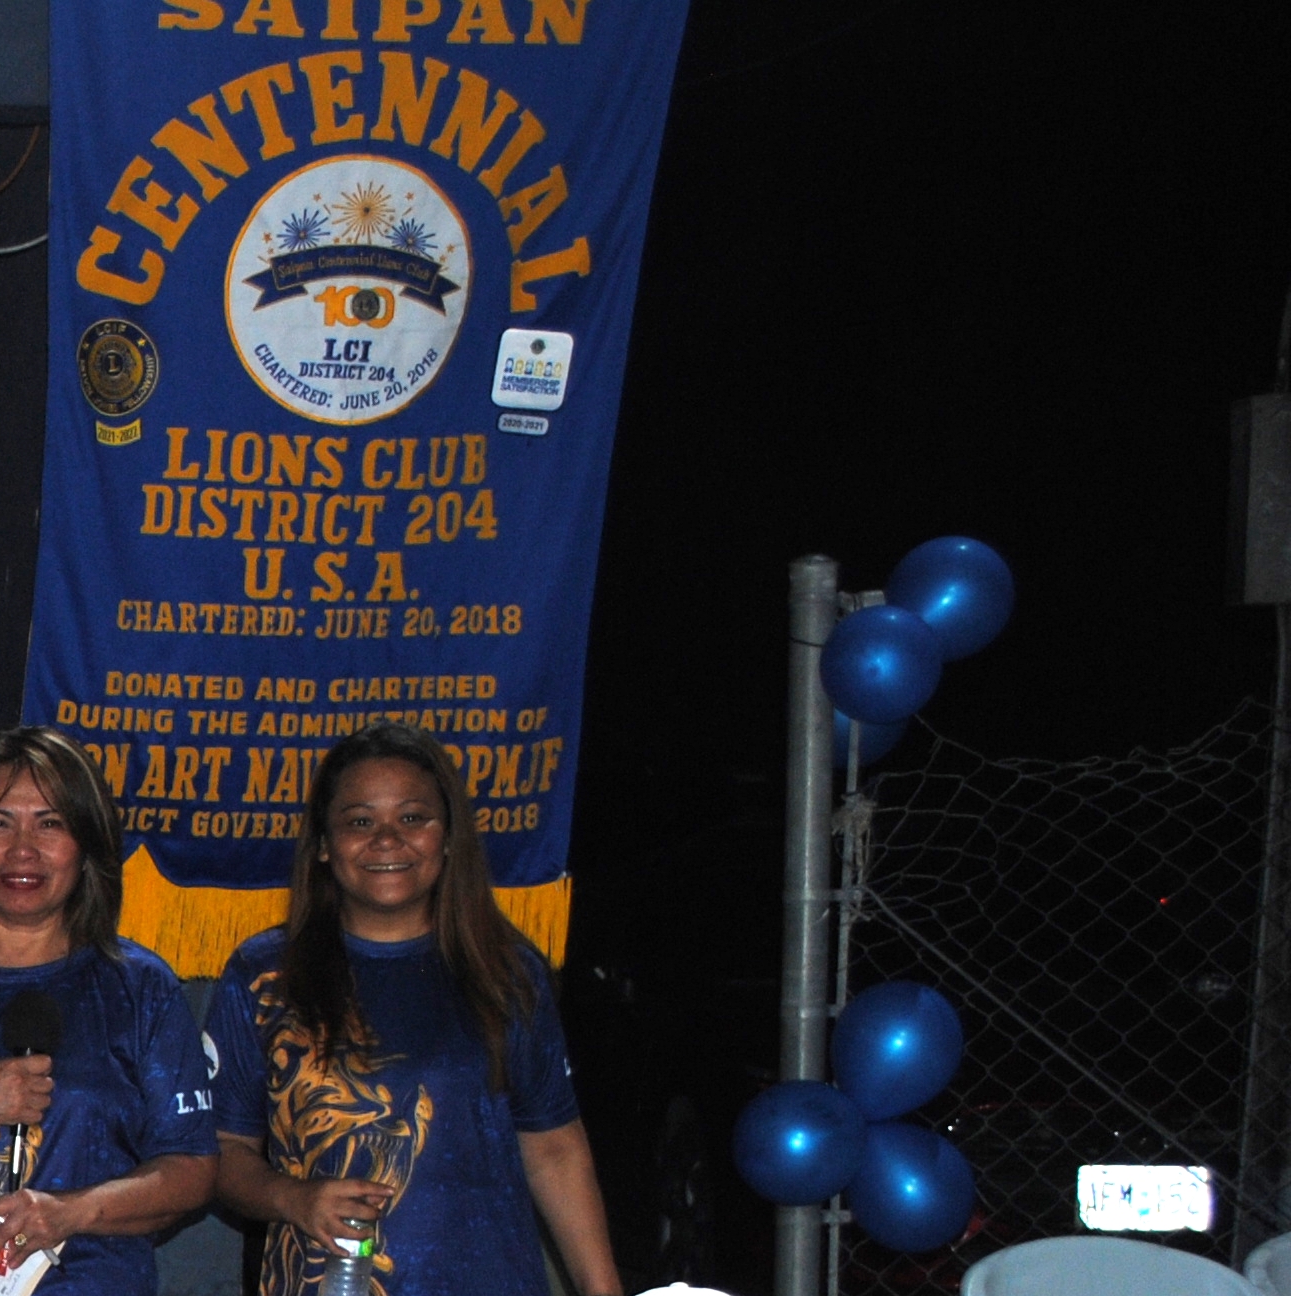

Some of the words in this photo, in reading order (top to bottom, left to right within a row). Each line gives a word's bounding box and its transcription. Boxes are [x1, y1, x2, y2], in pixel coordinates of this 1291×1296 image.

[76, 49, 591, 313] CENTENNIAL
[323, 338, 372, 363] LCI
[253, 343, 333, 408] CHARTERED:
[339, 391, 381, 411] JUNE
[384, 380, 409, 402] 20,
[407, 347, 439, 385] 2018
[298, 362, 366, 380] DISTRICT
[369, 365, 395, 382] 204
[162, 427, 350, 489] LIONS
[362, 434, 487, 490] CLUB
[139, 484, 386, 546] DISTRICT
[404, 488, 499, 545] 204
[116, 599, 306, 637] CHARTERED:
[314, 607, 391, 639] JUNE
[402, 605, 441, 639] 20,
[449, 604, 523, 636] 2018
[105, 671, 244, 700] DONATED
[254, 677, 317, 704] AND
[327, 674, 498, 703] CHARTERED
[56, 699, 175, 733] DURING
[187, 710, 248, 736] THE
[516, 707, 548, 732] OF
[135, 745, 232, 803] ART
[474, 801, 539, 833] 2018
